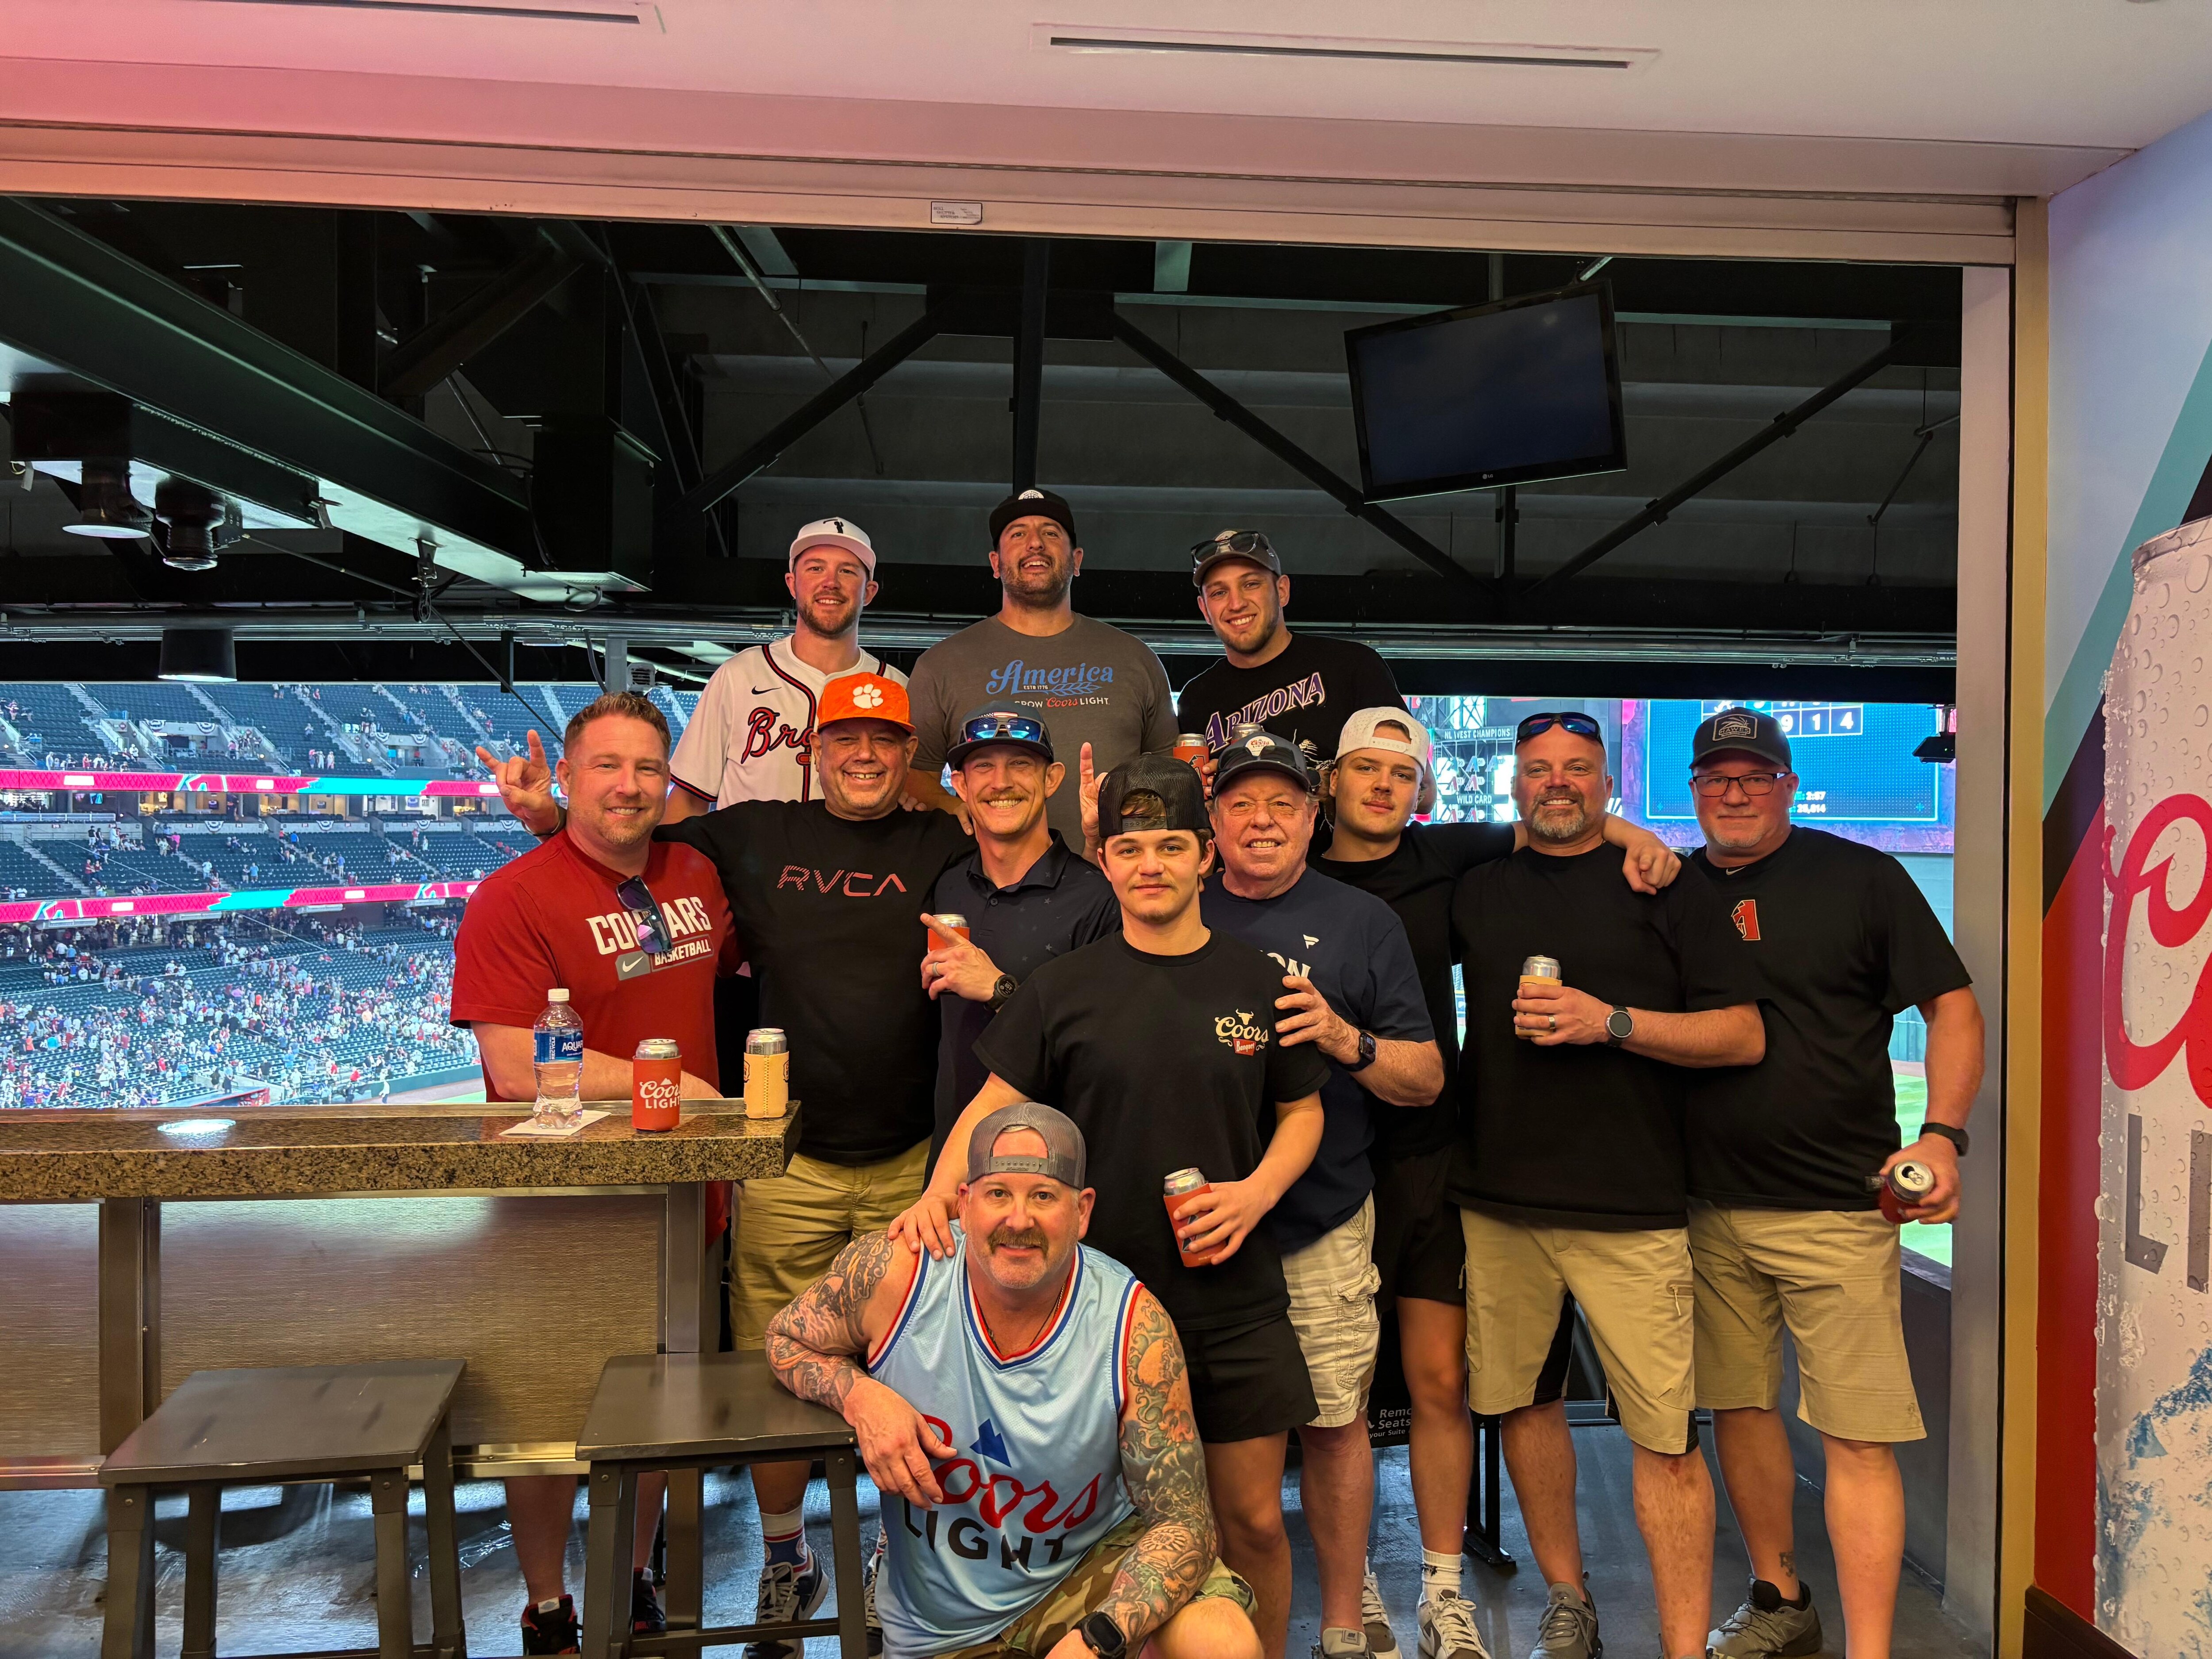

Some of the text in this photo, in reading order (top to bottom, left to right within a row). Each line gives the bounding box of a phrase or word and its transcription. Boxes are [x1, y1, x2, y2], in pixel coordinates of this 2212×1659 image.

[986, 660, 1114, 695] America
[1046, 697, 1078, 707] Coors
[1206, 672, 1325, 753] ARIZONA
[1473, 728, 1510, 737] CHAMPIONS
[1781, 711, 1854, 732] 9 1 4
[1457, 795, 1492, 804] WILD CARD
[777, 865, 907, 896] RVCA
[585, 897, 713, 955] COUARS
[655, 939, 711, 966] BASKETBALL
[1215, 1017, 1269, 1042] Coors
[1236, 1041, 1255, 1052] Banquet
[640, 1081, 680, 1098] Coor
[1379, 1418, 1411, 1429] Seats
[904, 1497, 1068, 1573] LIGHT
